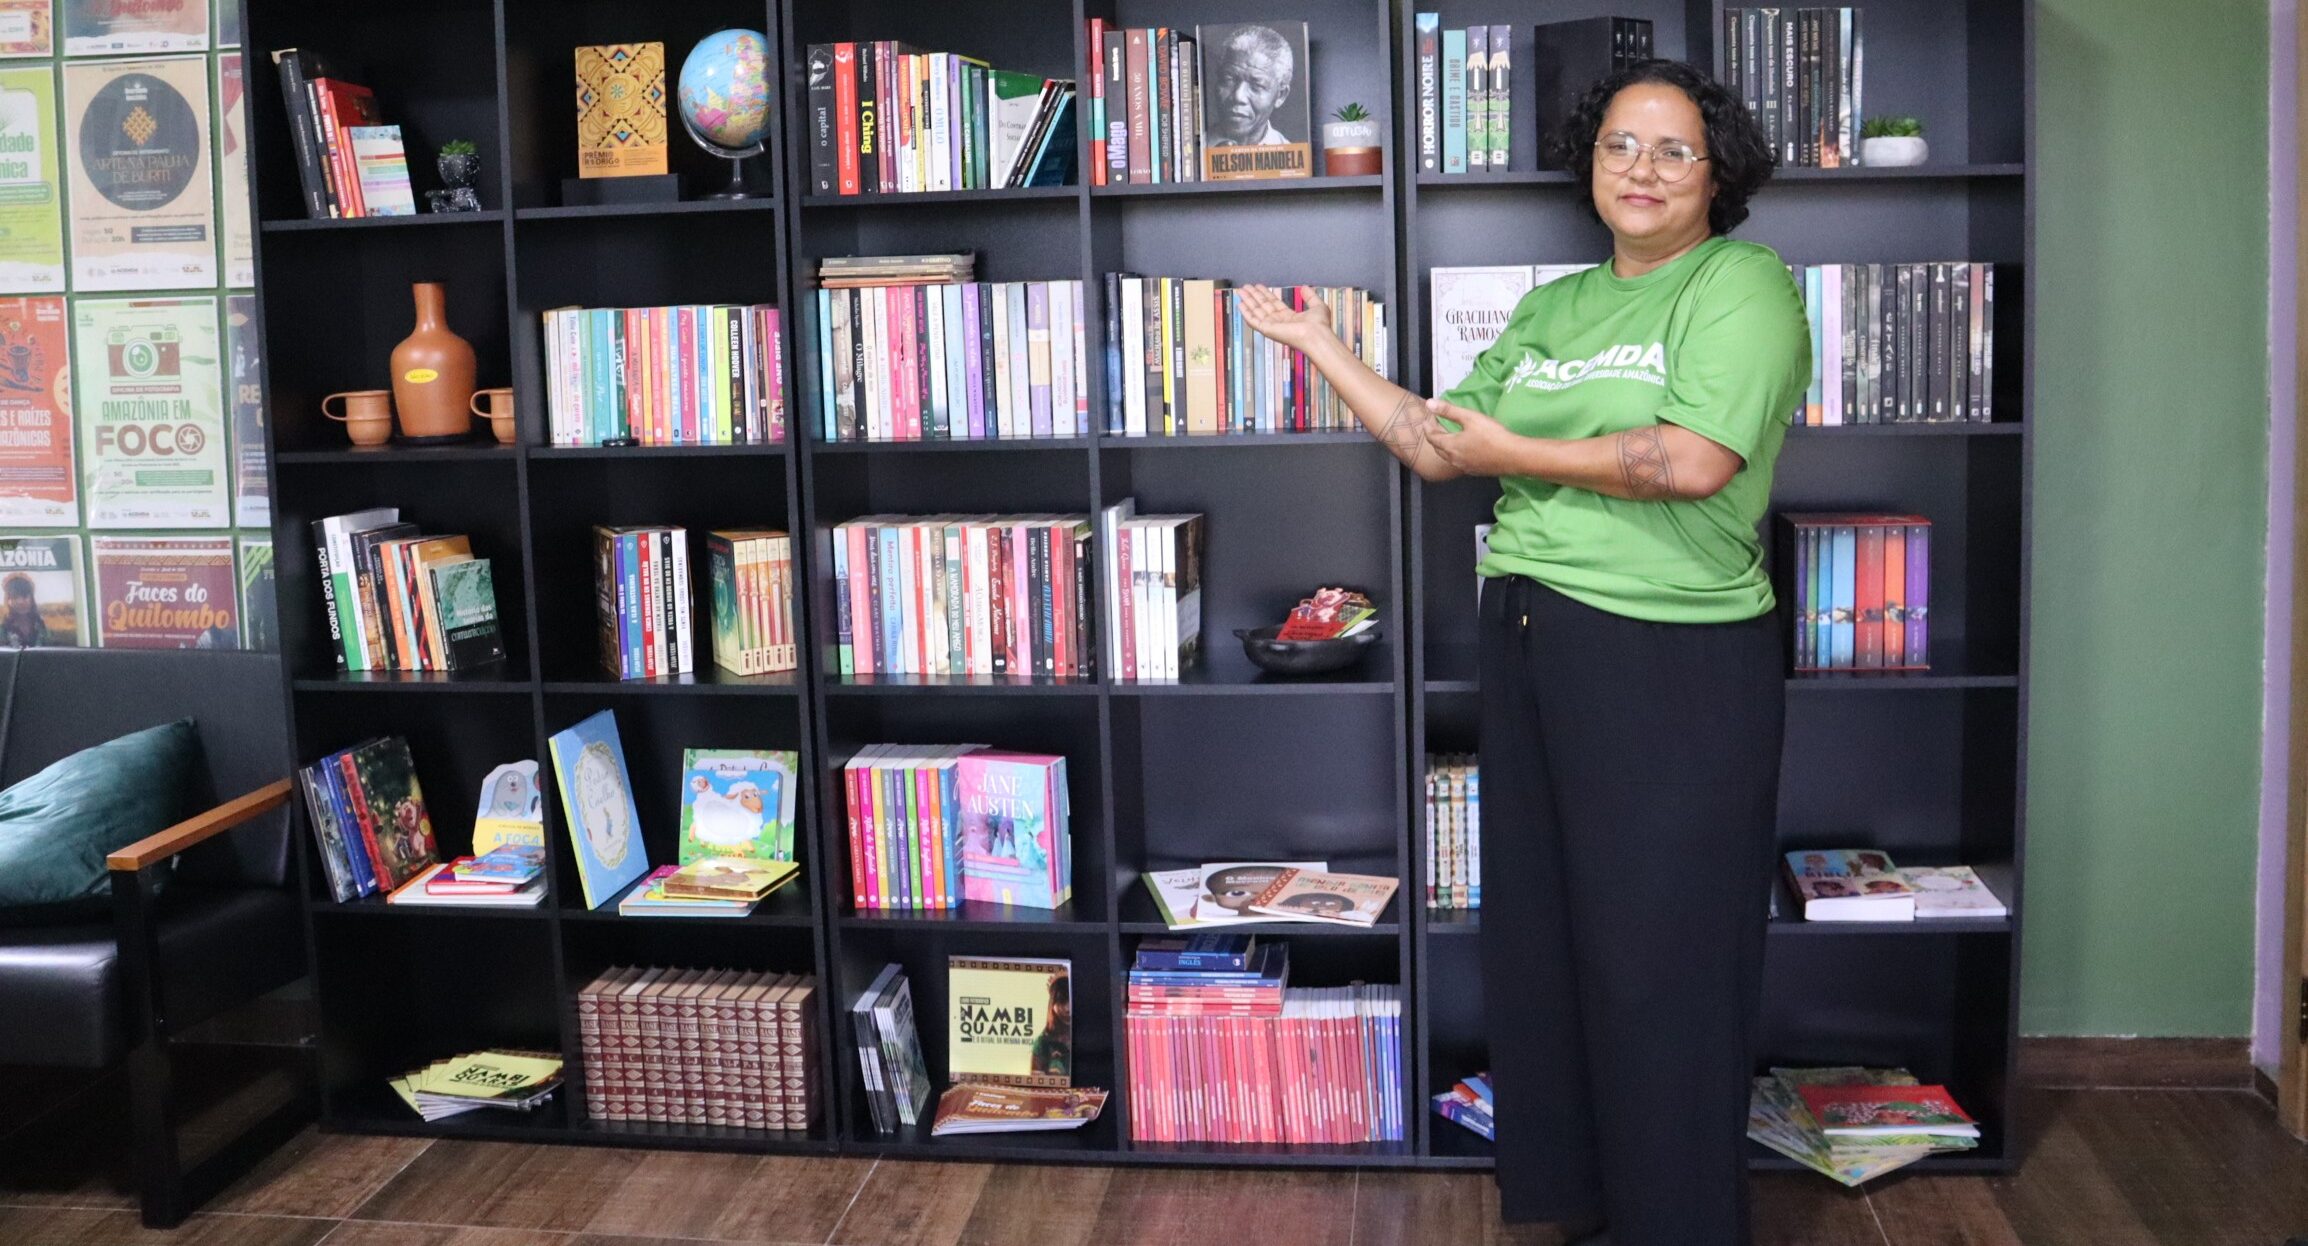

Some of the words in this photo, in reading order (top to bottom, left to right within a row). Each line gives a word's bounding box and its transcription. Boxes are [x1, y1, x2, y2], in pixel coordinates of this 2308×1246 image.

[1786, 21, 1794, 46] MAIS
[1158, 45, 1168, 73] DAVID
[1786, 47, 1794, 88] ESCURO
[1134, 72, 1141, 83] 50
[1422, 55, 1434, 95] NOIRE
[862, 100, 873, 108] I
[1159, 76, 1169, 109] BOWIE
[817, 106, 830, 138] capital
[861, 110, 874, 154] Ching
[1423, 96, 1435, 155] HORROR
[1211, 153, 1253, 173] NELSON
[1254, 150, 1305, 171] MANDELA
[730, 319, 739, 350] COLLEEN
[731, 350, 740, 379] HOOVER
[855, 352, 864, 383] Milagre
[1622, 368, 1666, 387] AMAZÔNICA
[101, 395, 169, 421] AMAZÔNIA
[173, 399, 192, 420] EM
[933, 530, 942, 568] NICHOLAS
[317, 547, 330, 579] PORTA
[125, 580, 178, 605] Faces
[184, 582, 208, 603] do
[322, 580, 333, 601] DOS
[950, 572, 960, 610] NAMORADA
[107, 600, 230, 631] Quilombo
[325, 602, 341, 640] FUNDOS
[952, 610, 960, 619] DO
[952, 619, 961, 631] MEU
[952, 631, 962, 652] AMIGO
[977, 771, 1023, 798] JANE
[967, 797, 1035, 820] AUSTEN
[960, 1005, 1033, 1024] NAMBI
[960, 1022, 1034, 1037] QUARAS
